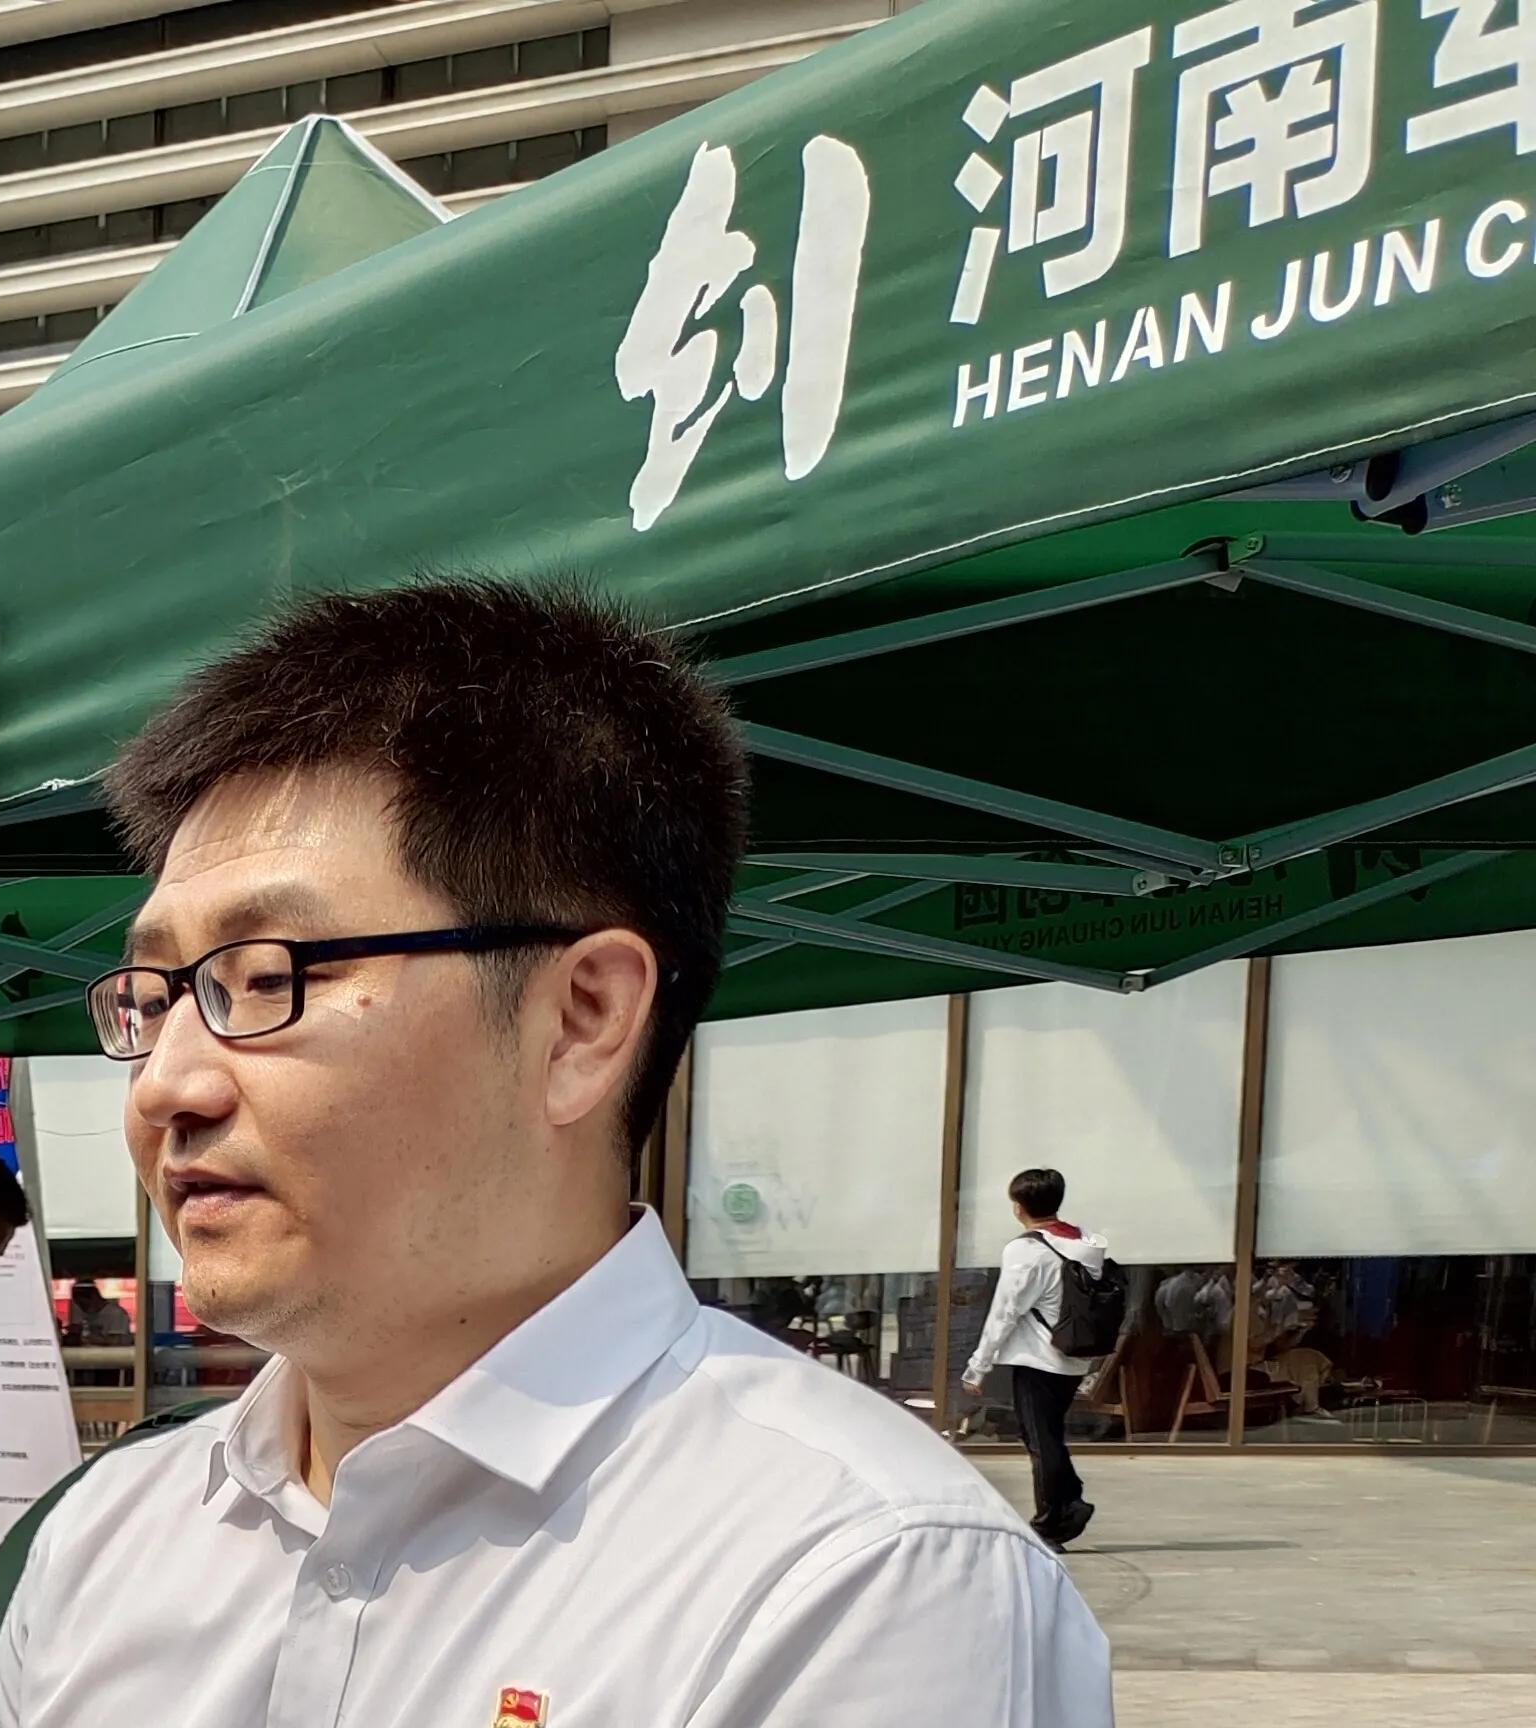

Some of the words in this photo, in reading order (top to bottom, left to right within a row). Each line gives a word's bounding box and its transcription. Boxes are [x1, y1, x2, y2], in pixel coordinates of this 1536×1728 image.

[953, 281, 1231, 428] HENAN
[1251, 218, 1440, 338] JUN
[1465, 199, 1536, 278] C
